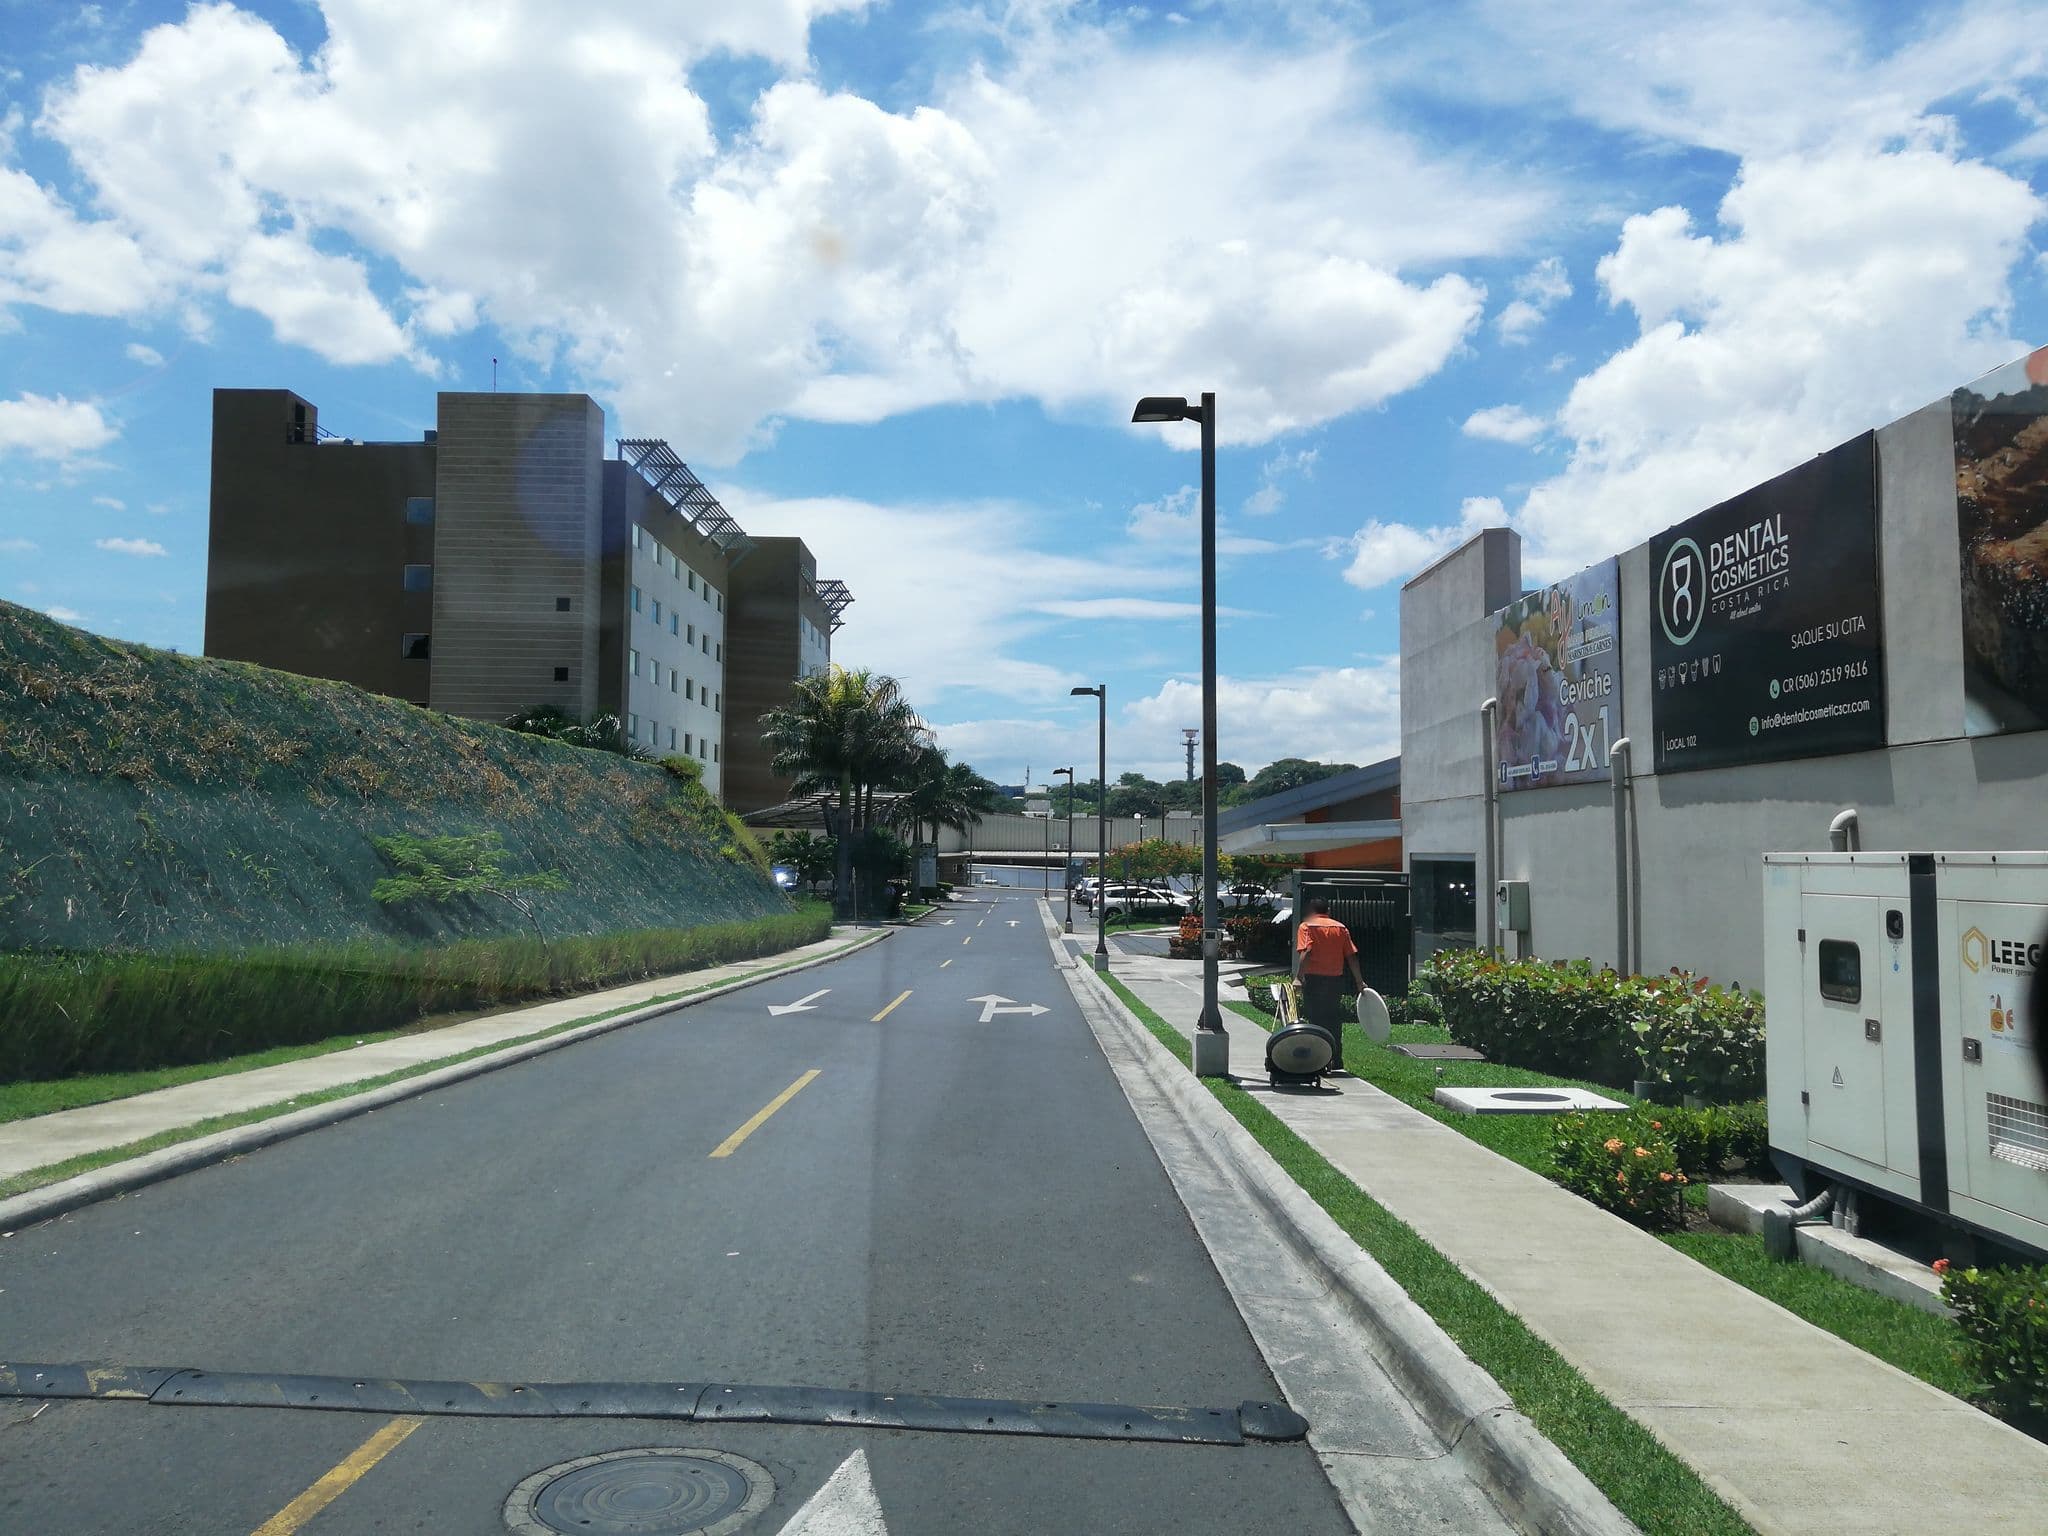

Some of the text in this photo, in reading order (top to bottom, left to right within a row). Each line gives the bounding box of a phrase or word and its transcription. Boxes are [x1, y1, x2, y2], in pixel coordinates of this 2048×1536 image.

[1710, 513, 1789, 571] DENTAL
[1711, 544, 1789, 593] COSMETICS
[1712, 576, 1790, 613] COSTA RICA
[1791, 616, 1866, 649] SAQUE SU CITA
[1560, 670, 1612, 706] Ceviche
[1820, 666, 1841, 684] 2519
[1844, 660, 1868, 679] 9616
[1761, 700, 1870, 730] info@dentalcosmeticscr.com
[1564, 705, 1610, 772] 2x1
[1666, 735, 1697, 751] LOCAL 102
[1991, 966, 2014, 975] Power
